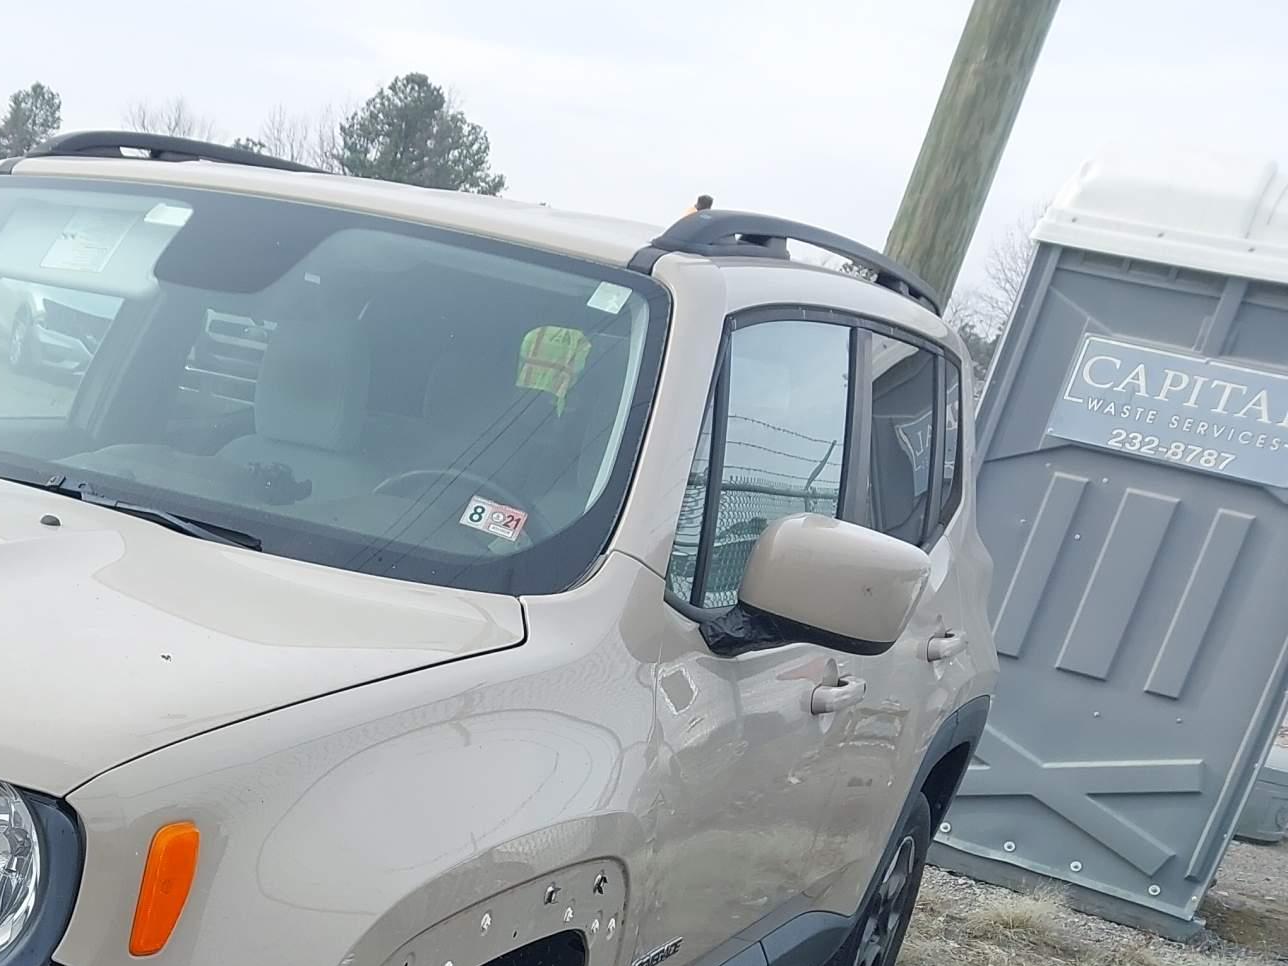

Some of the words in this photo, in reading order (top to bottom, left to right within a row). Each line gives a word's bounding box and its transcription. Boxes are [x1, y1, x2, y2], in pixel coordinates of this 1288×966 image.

[1087, 396, 1159, 424] WASTE
[1168, 415, 1281, 451] SERVICES
[1107, 429, 1237, 470] 232-8787
[469, 505, 485, 522] 8
[503, 514, 521, 530] 21
